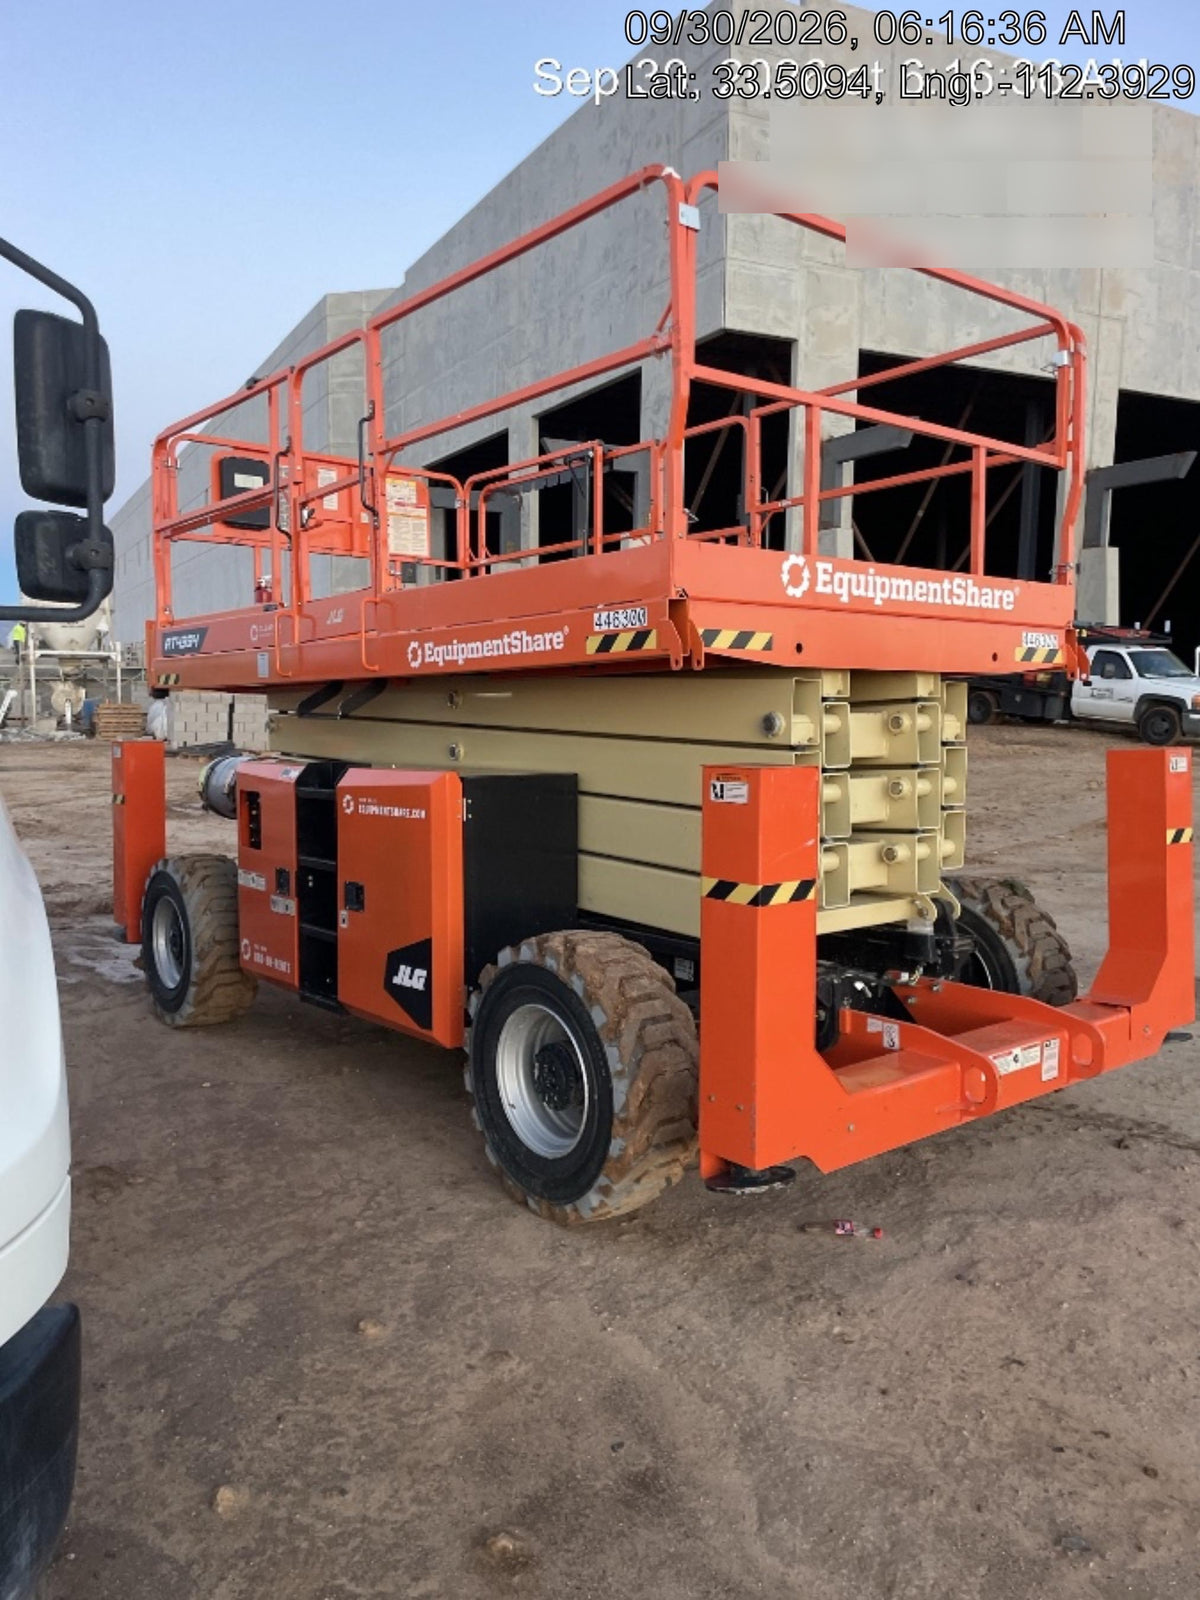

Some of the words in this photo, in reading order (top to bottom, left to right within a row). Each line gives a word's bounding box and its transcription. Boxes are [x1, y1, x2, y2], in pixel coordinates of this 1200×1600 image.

[815, 561, 1014, 610] EquipmentShare
[424, 628, 565, 666] EquipmentShare
[392, 965, 427, 991] JLG
